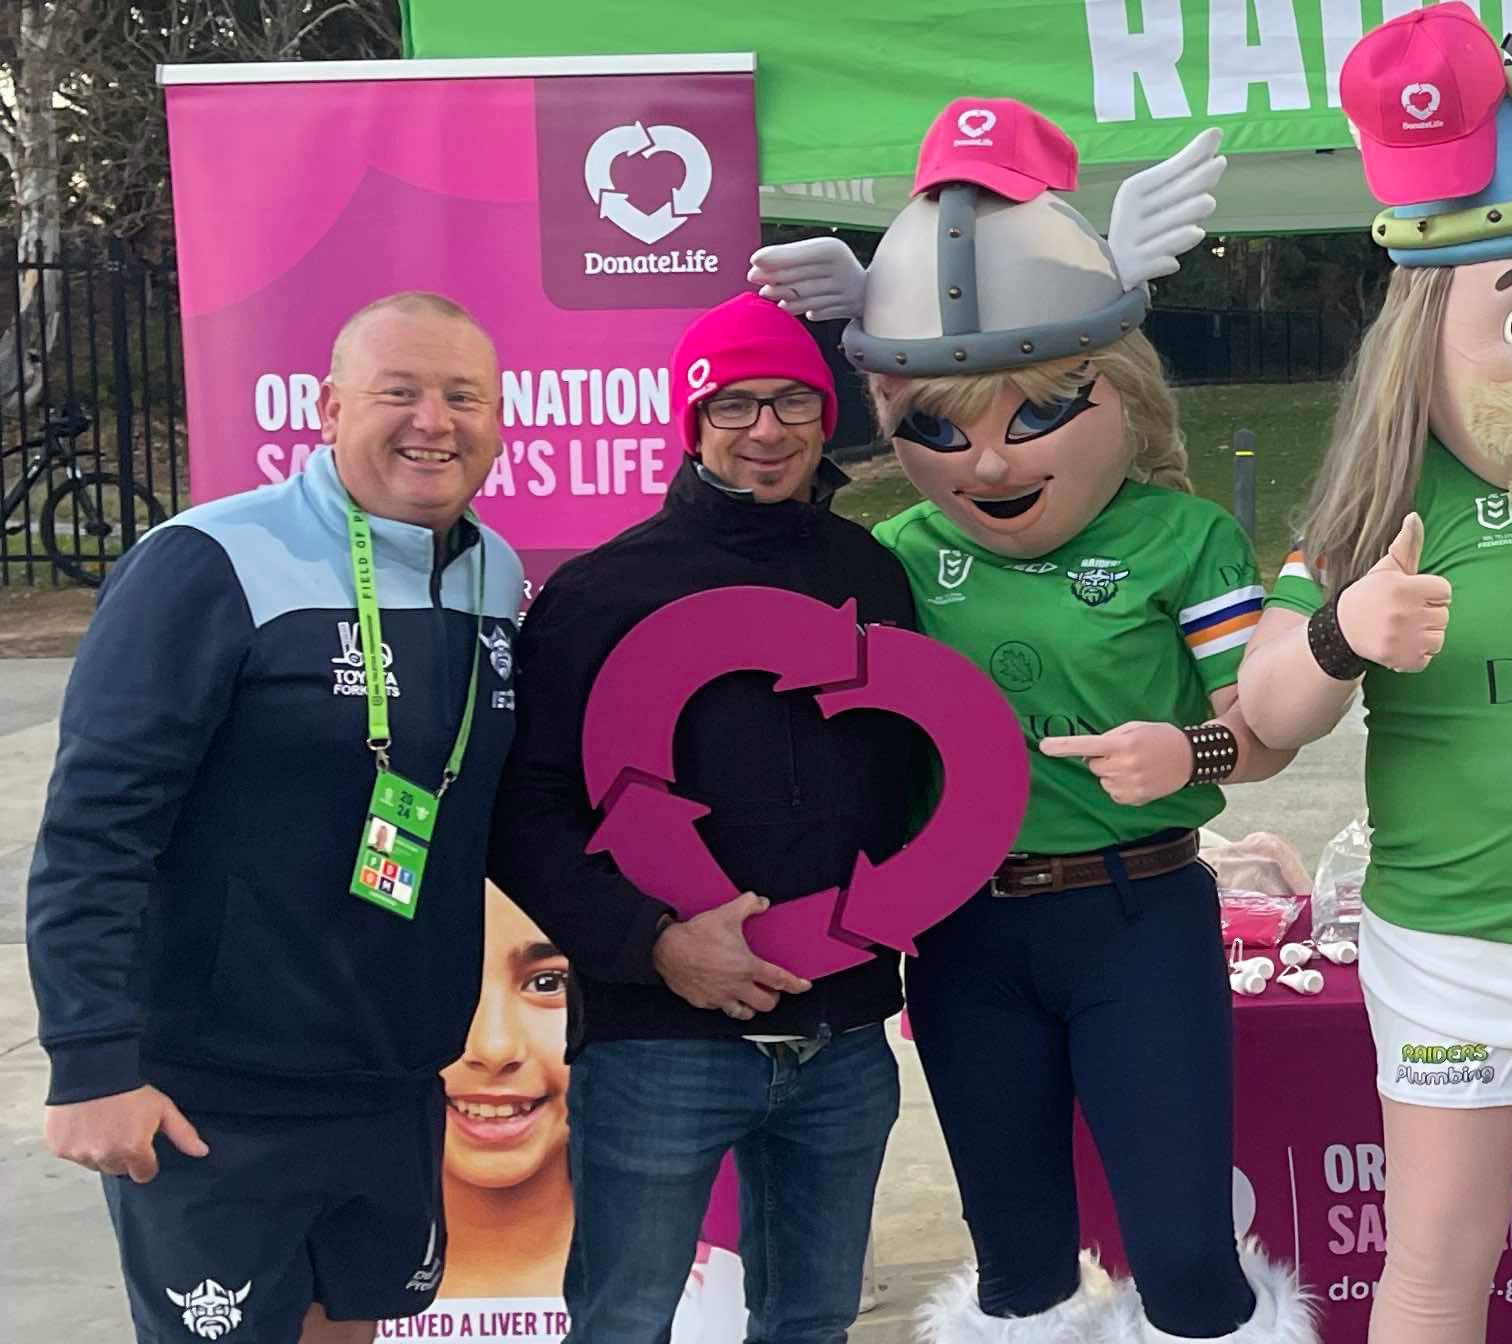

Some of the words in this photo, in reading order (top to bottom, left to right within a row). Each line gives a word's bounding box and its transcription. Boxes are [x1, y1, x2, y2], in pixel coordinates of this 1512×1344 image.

[584, 249, 718, 275] DonateLife
[255, 373, 323, 431] OR
[502, 368, 671, 427] NATION
[475, 439, 556, 496] A'S
[568, 437, 667, 495] LIFE
[359, 557, 372, 600] FIELD
[333, 669, 398, 686] TOYA
[1401, 1043, 1490, 1064] RAIDERS
[1396, 1064, 1495, 1085] Plumbing
[1324, 1143, 1386, 1193] OR
[1328, 1204, 1387, 1254] SA
[376, 1312, 454, 1338] CEIVED
[459, 1313, 473, 1338] A
[479, 1312, 537, 1337] LIVER
[543, 1312, 568, 1336] TR
